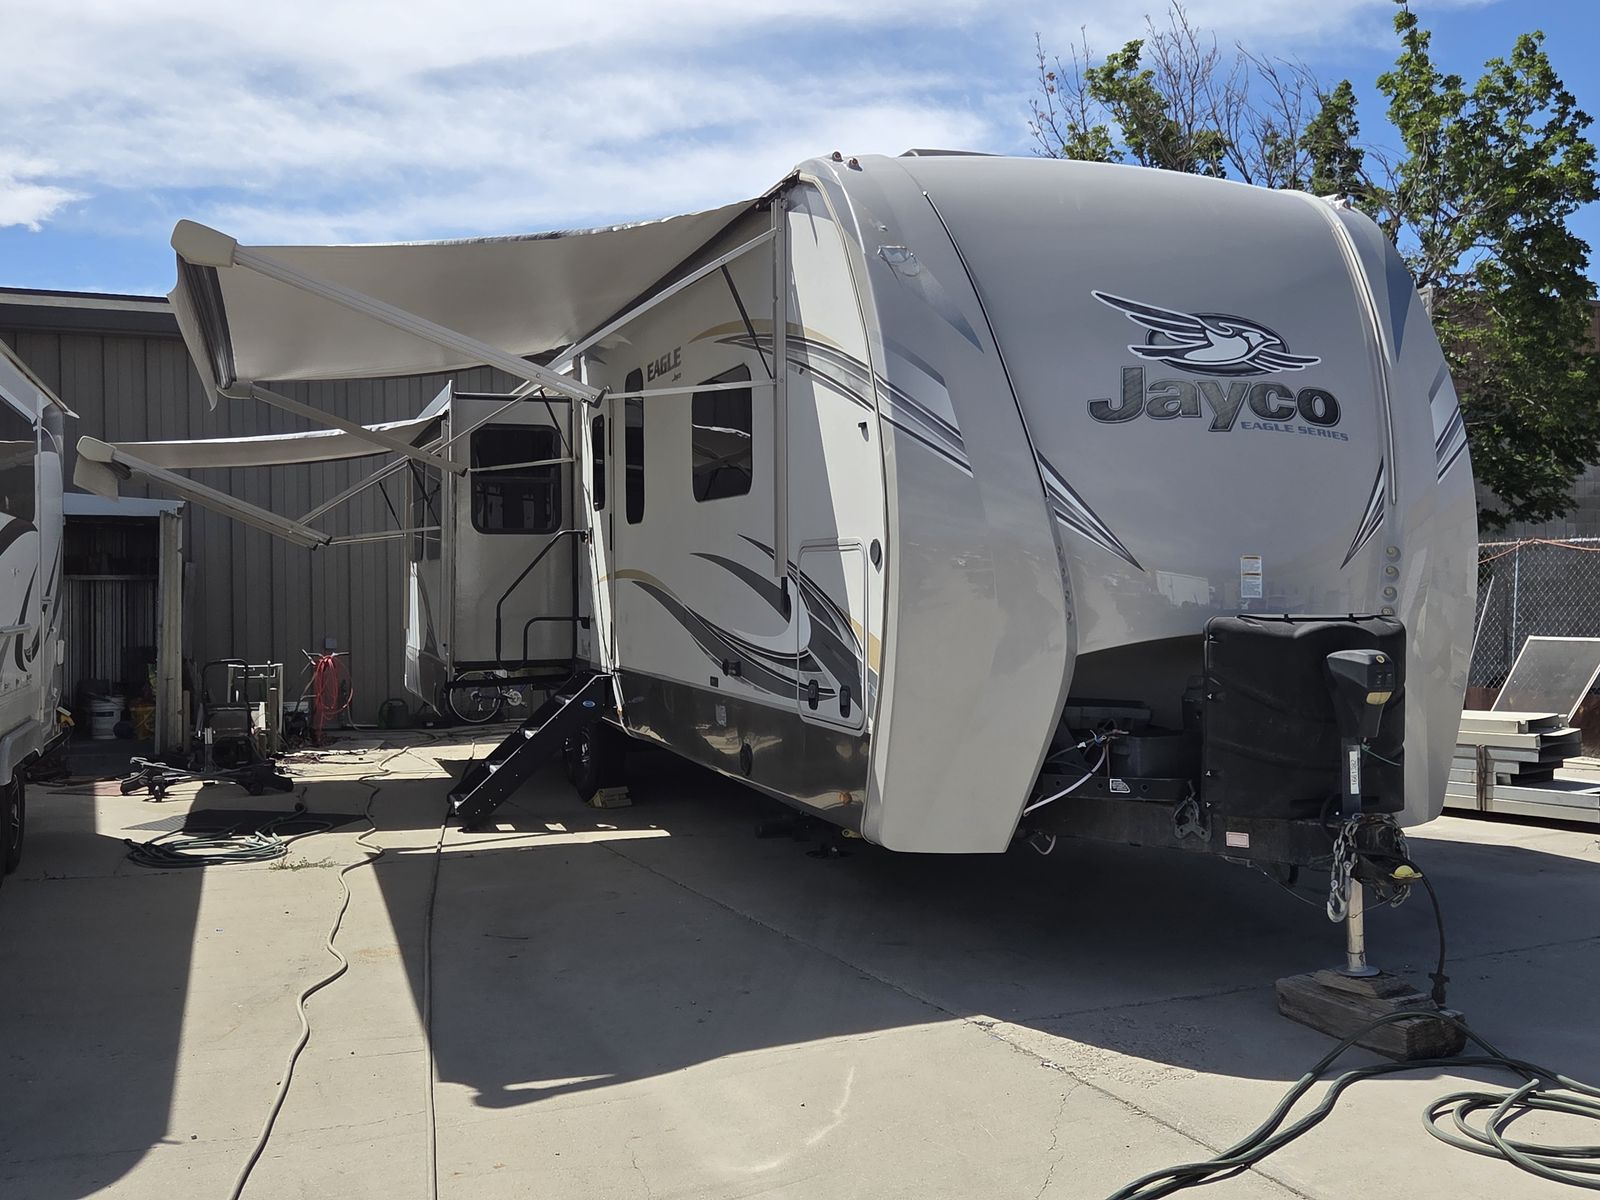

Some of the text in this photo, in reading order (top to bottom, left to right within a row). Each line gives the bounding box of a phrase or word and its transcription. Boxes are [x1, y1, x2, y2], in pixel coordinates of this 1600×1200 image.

[647, 346, 682, 382] EAGLE
[1087, 365, 1341, 432] Jayco
[1240, 421, 1349, 441] EAGLE SERIES
